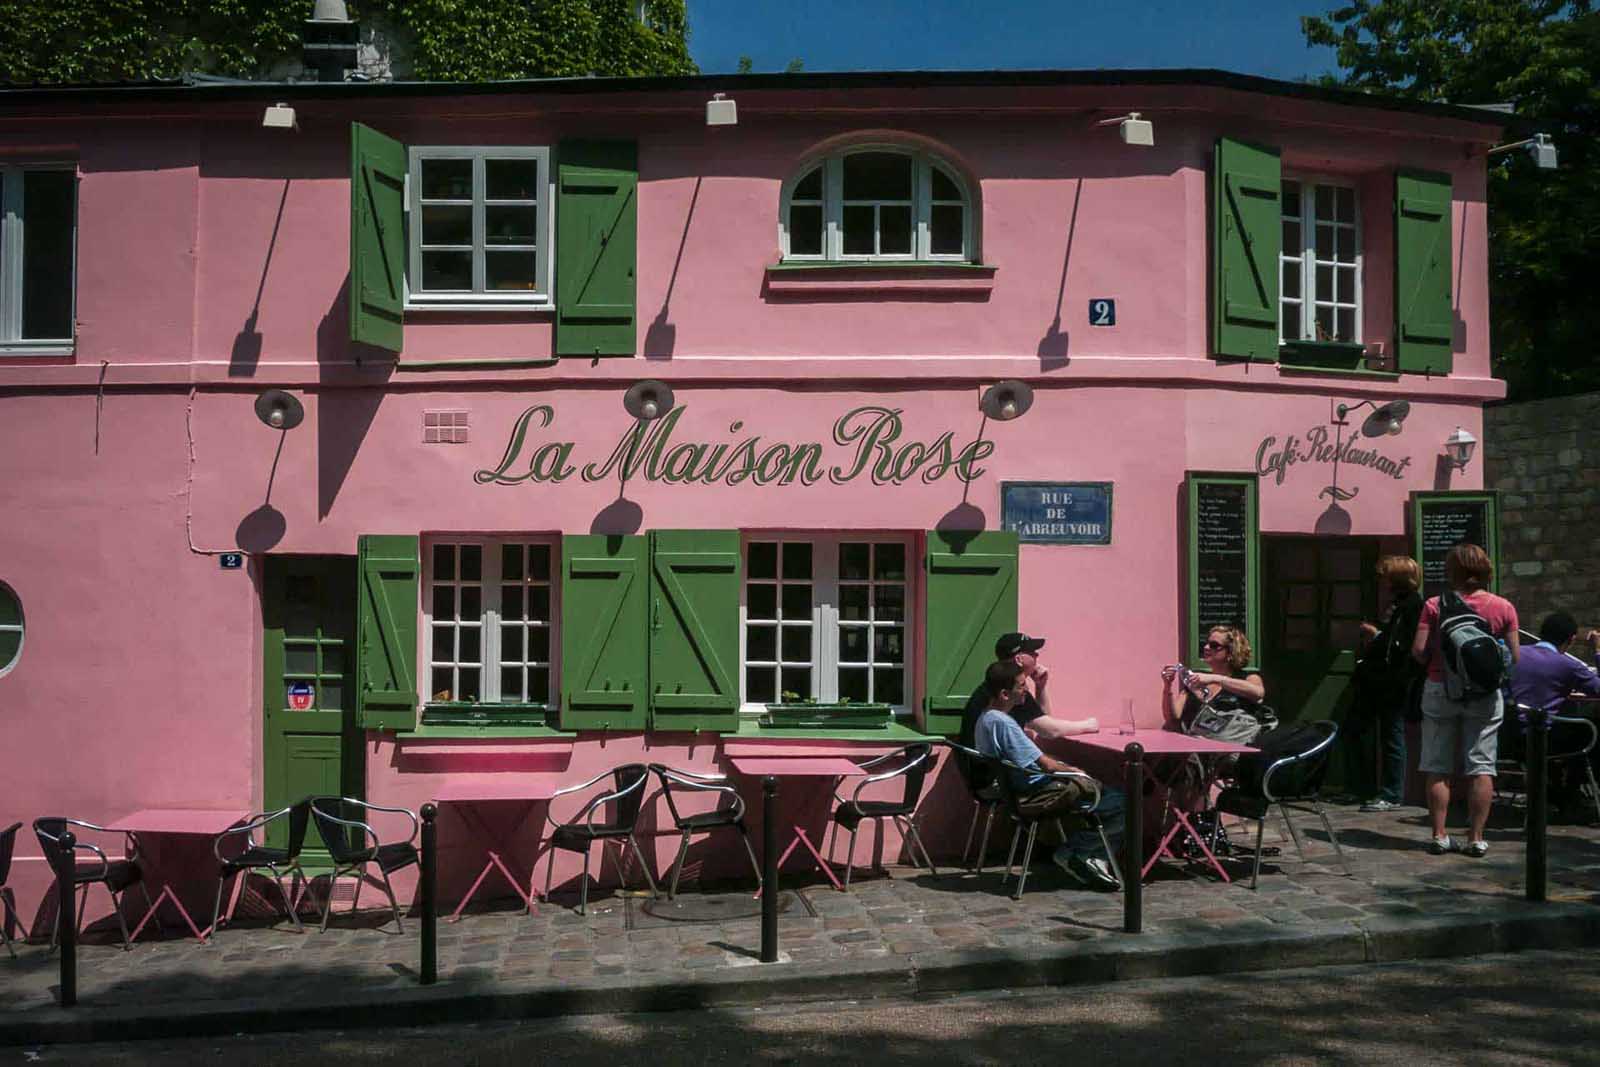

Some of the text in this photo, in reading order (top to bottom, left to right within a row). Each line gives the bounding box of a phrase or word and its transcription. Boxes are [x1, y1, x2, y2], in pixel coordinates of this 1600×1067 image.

[1095, 301, 1109, 324] 2
[473, 403, 995, 487] La Maison Rose
[1041, 492, 1073, 505] RUE
[1046, 508, 1067, 519] DE
[227, 555, 236, 567] 2
